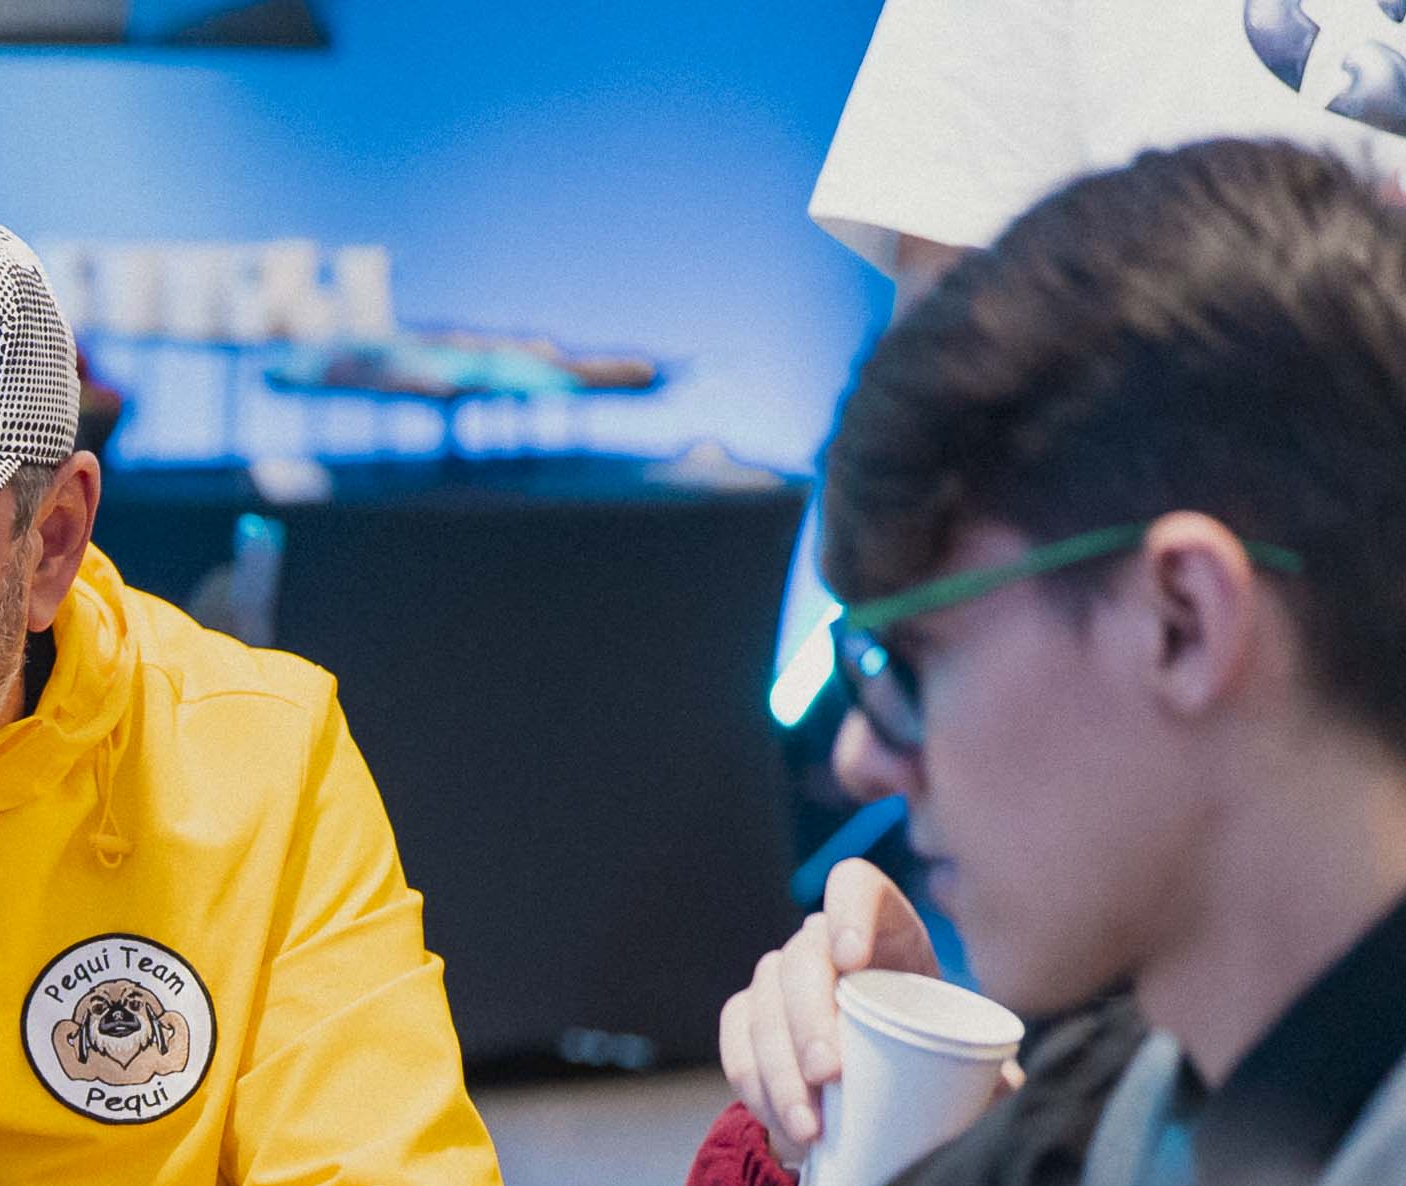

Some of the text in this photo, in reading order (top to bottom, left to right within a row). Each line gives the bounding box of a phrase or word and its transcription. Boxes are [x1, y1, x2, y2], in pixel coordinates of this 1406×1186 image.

[44, 946, 186, 1003] Pequi Team
[85, 1081, 169, 1118] Pequi
